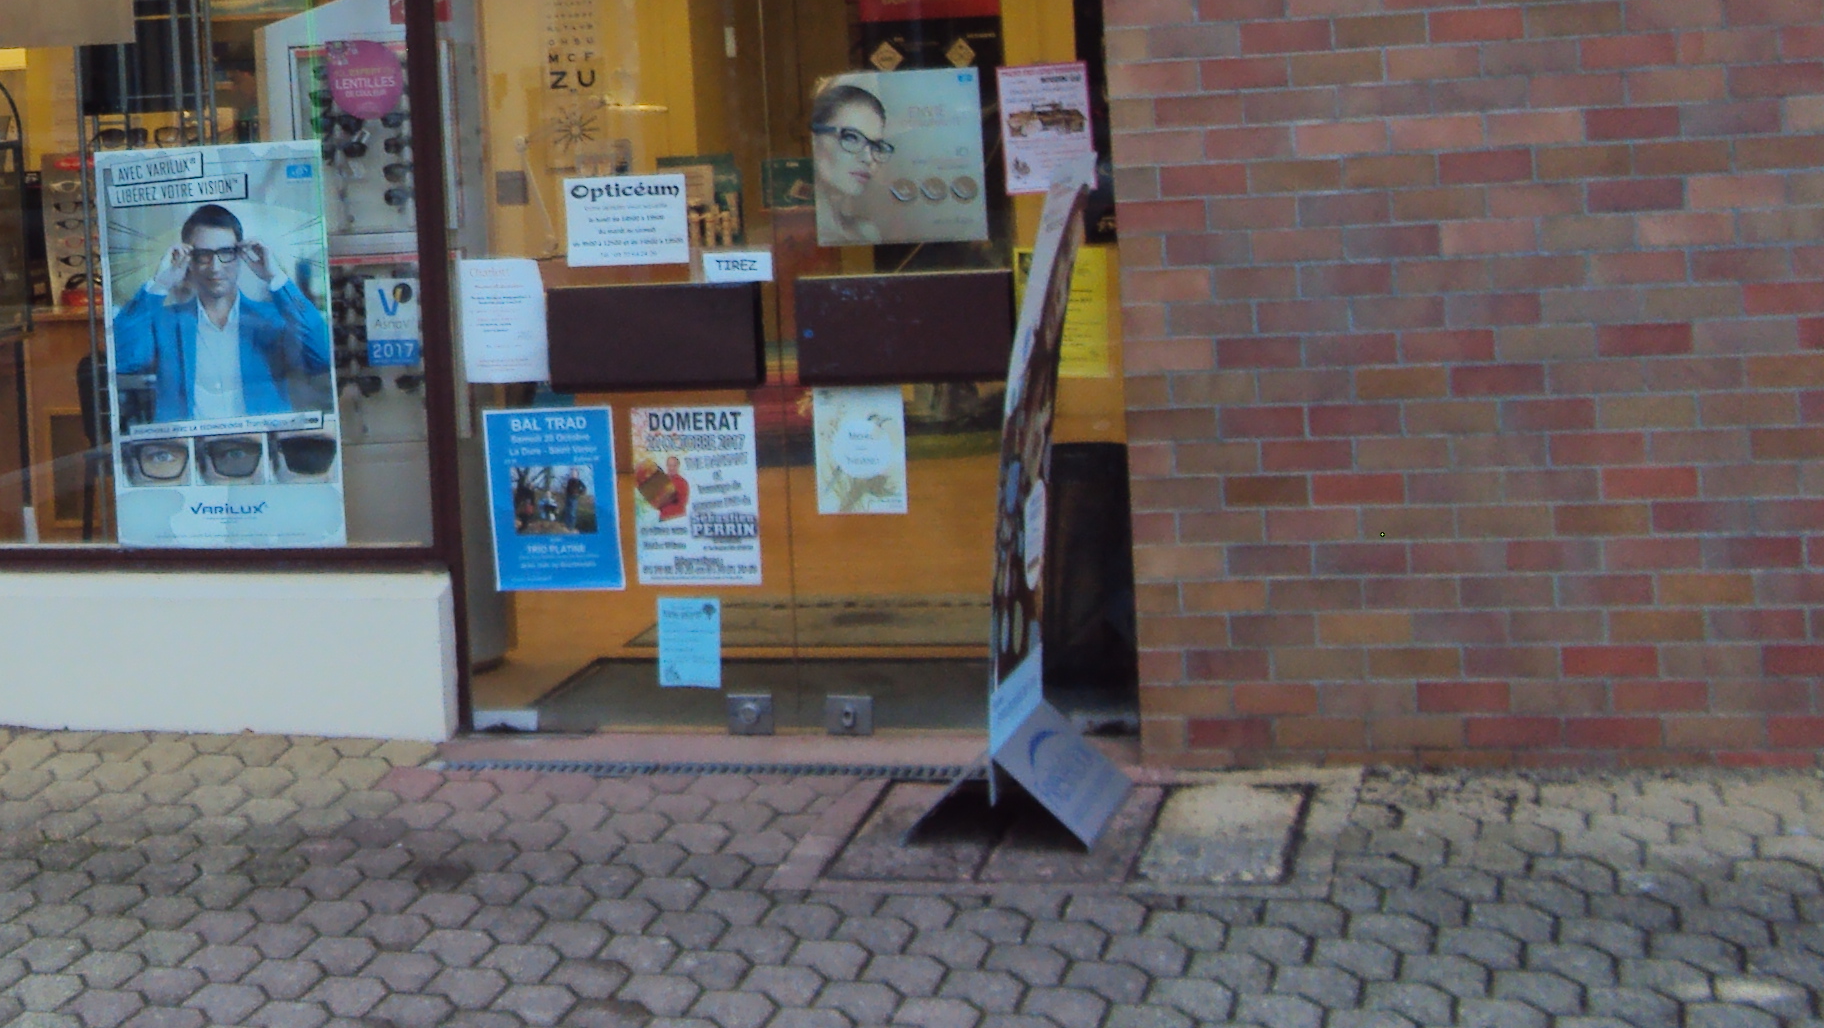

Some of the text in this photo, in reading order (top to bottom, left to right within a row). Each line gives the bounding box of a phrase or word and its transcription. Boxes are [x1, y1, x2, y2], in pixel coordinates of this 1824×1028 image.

[334, 76, 396, 90] LENTILLES
[118, 167, 143, 182] AVEC
[161, 183, 194, 199] VOTRE
[570, 182, 679, 202] Opticéum
[716, 259, 758, 271] TIREZ
[372, 343, 414, 359] 2017
[510, 416, 587, 432] BAL TRAD
[648, 411, 742, 432] DOMERAT
[692, 523, 756, 537] PERRIN
